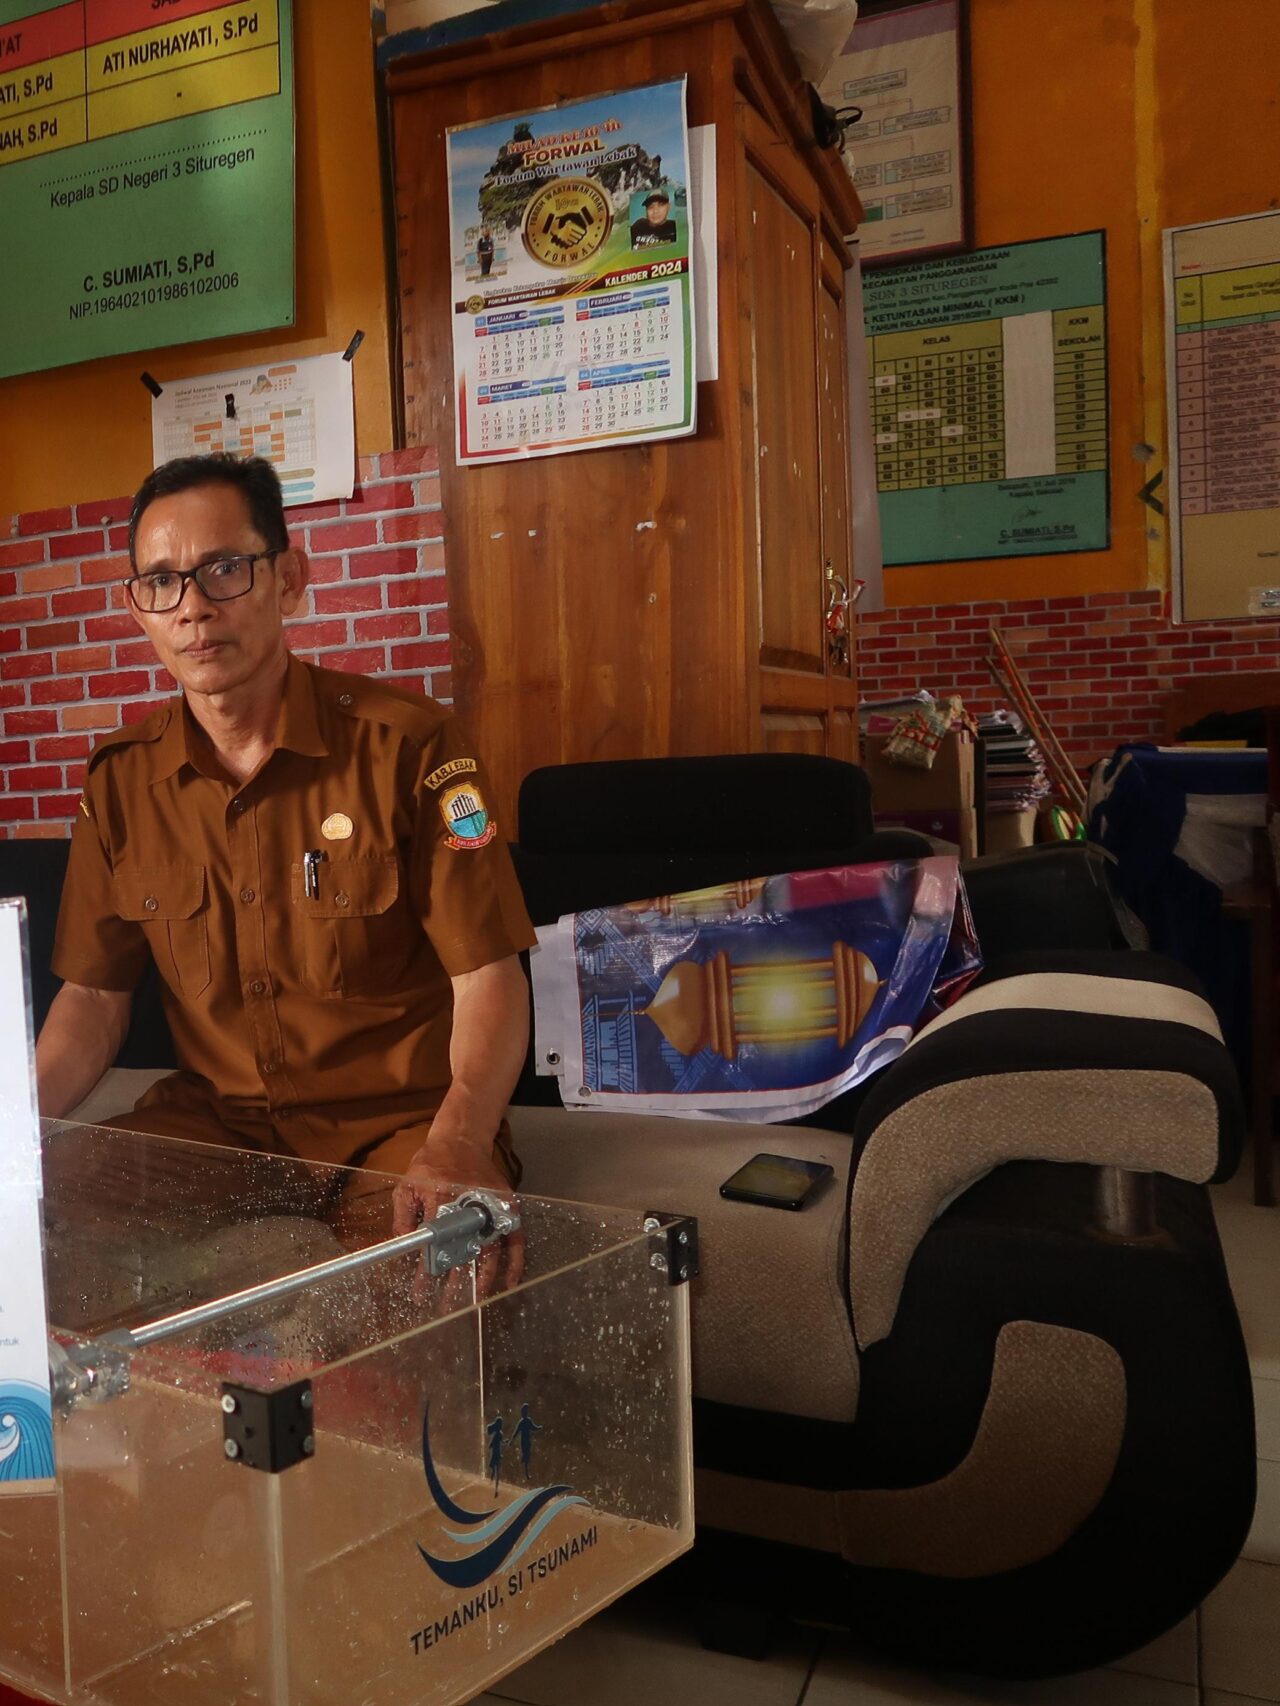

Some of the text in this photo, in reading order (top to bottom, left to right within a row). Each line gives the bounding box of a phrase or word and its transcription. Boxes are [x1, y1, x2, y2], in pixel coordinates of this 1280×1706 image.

[102, 53, 125, 75] ATI
[223, 13, 258, 40] S.Pd
[23, 72, 53, 97] S.Pd
[27, 117, 57, 142] S.Pd
[524, 139, 606, 166] FORWAL
[50, 147, 255, 208] Kepala SD Negeri 3 Situregen
[495, 170, 536, 186] Forum
[535, 157, 600, 178] Wartawan
[544, 242, 596, 263] FORWAL
[925, 260, 944, 271] DAN
[946, 251, 1011, 268] KEBUDAYAAN
[83, 275, 98, 293] C.
[103, 259, 172, 289] SUMIATI,
[605, 271, 649, 287] KALENDER
[650, 261, 683, 277] 2024
[919, 262, 998, 282] PANGGARANGAN
[538, 288, 557, 297] LEBAK
[590, 295, 622, 307] FEBRUARI
[869, 289, 895, 303] SDN
[911, 275, 989, 296] SITUREGEN
[488, 314, 517, 324] JANUARI
[871, 305, 941, 323] KETUNTASAN
[942, 299, 986, 315] MINIMAL
[870, 322, 899, 333] TAHUN
[922, 335, 951, 346] KELAS
[1057, 335, 1102, 347] SEKOLAH
[491, 384, 513, 393] MARET
[410, 1526, 598, 1655] TEMANKU, SI TSUNAMI
